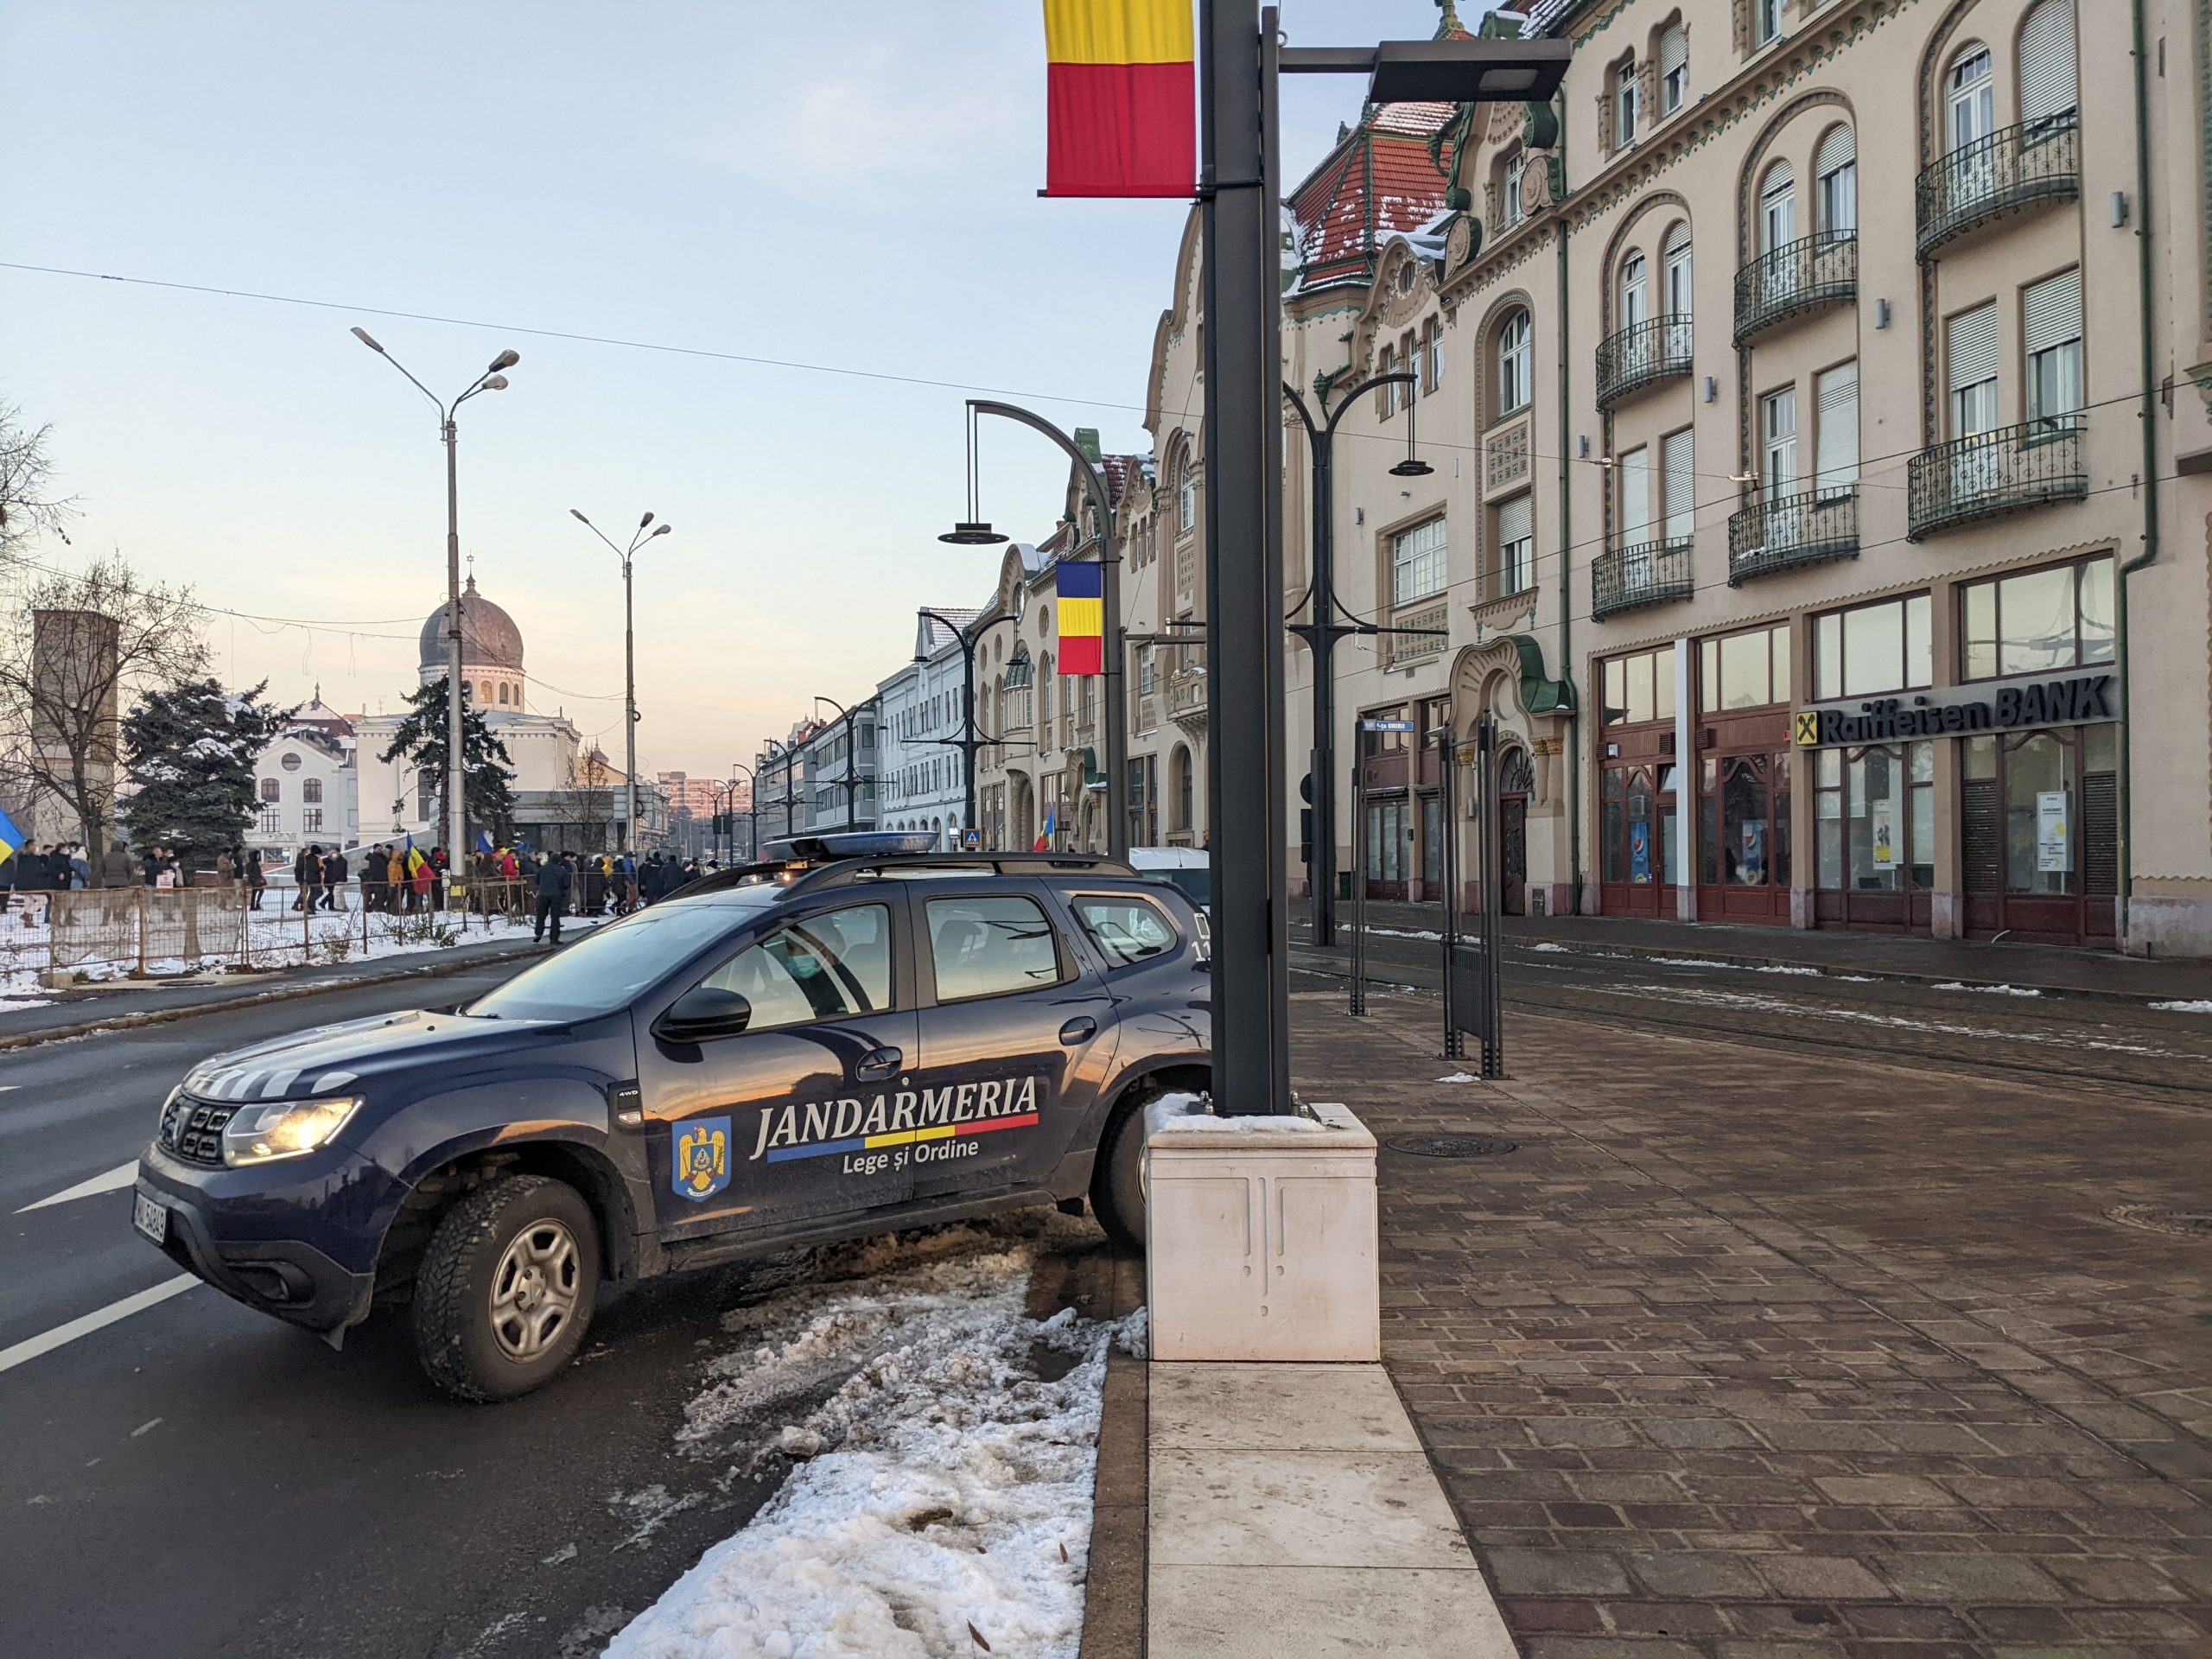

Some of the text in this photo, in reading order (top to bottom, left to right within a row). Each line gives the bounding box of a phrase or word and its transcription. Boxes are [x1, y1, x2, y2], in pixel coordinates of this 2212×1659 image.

[1821, 675, 2111, 743] Raiffeisen BANK
[750, 1076, 1038, 1160] JANDARMERIA
[842, 1140, 979, 1175] Lege și Ordine
